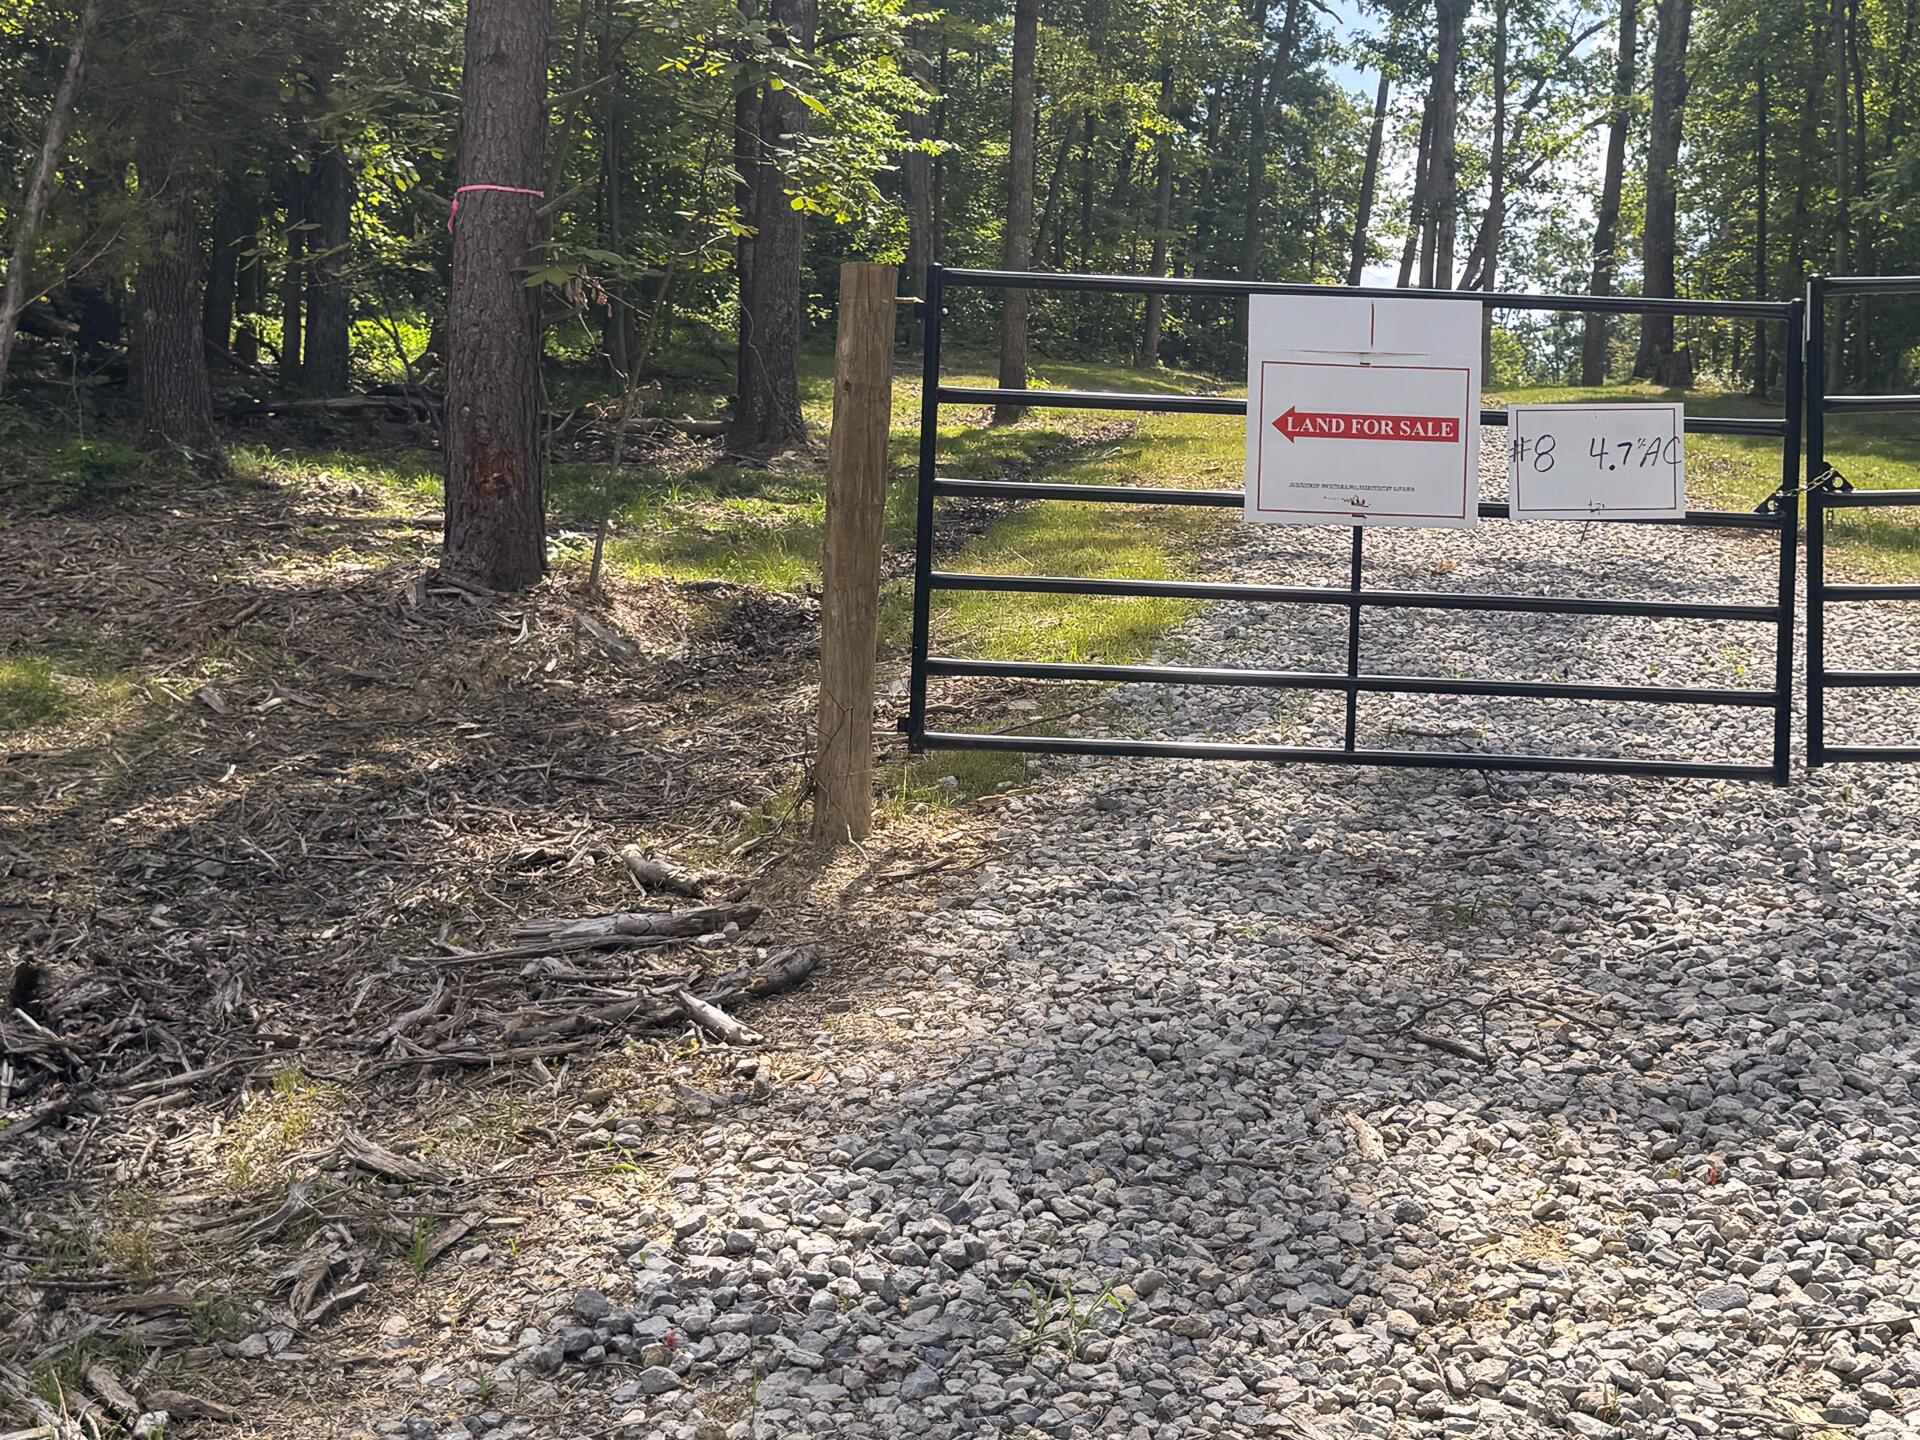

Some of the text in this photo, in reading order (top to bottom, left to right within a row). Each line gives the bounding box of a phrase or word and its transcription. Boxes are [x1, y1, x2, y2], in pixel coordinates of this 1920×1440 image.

[1286, 416, 1454, 438] LAND FOR SALE
[1509, 434, 1556, 472] #8
